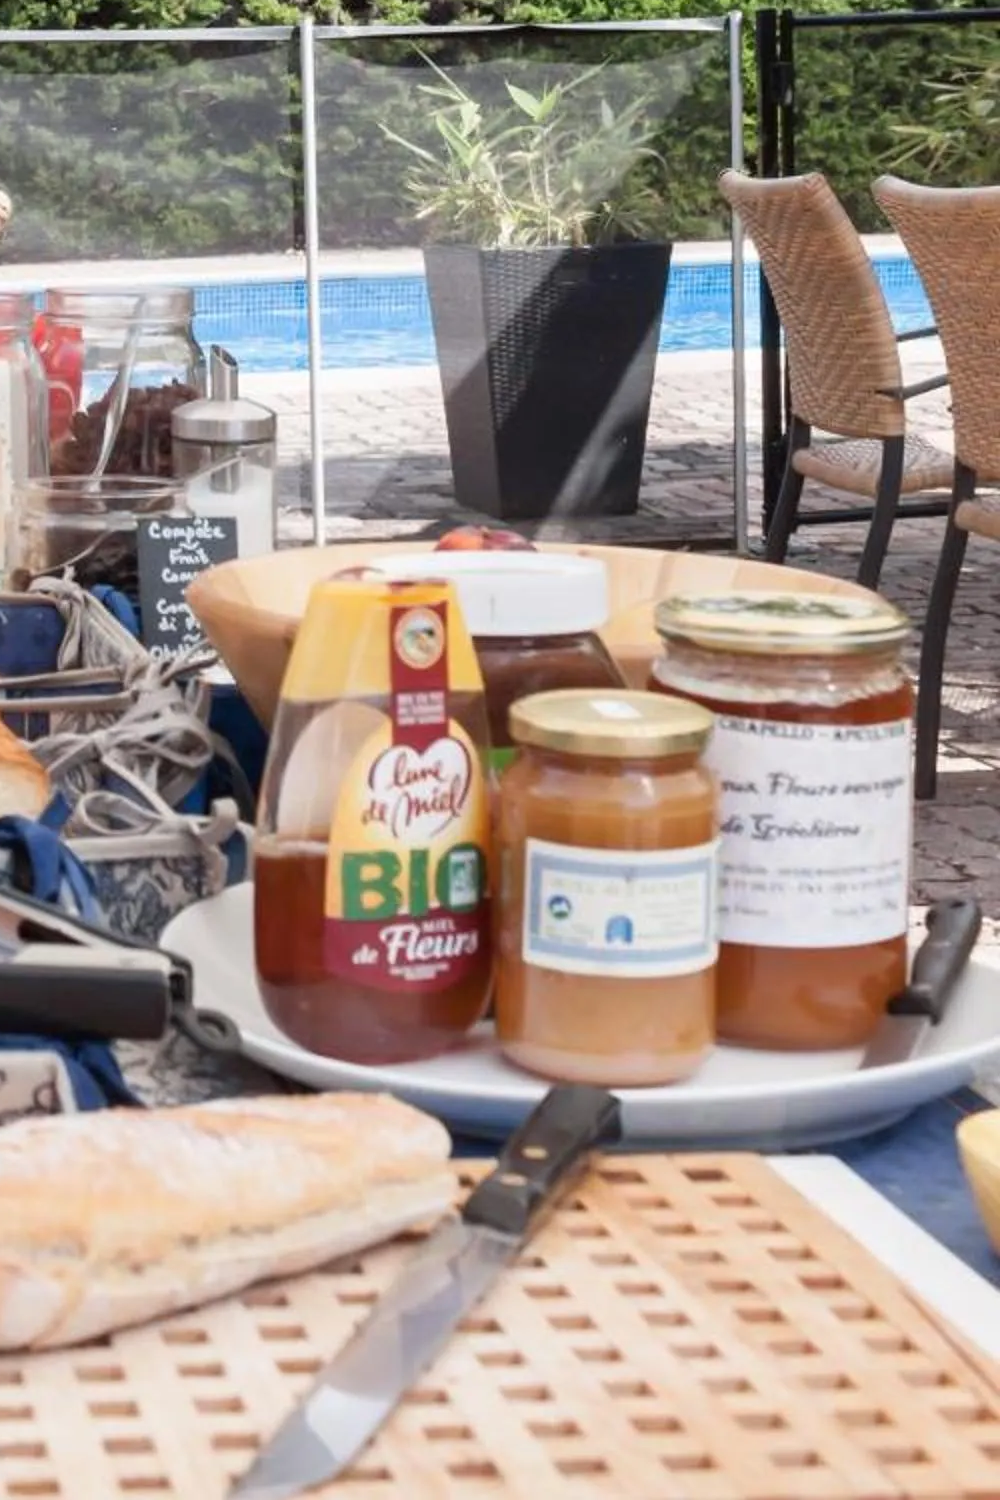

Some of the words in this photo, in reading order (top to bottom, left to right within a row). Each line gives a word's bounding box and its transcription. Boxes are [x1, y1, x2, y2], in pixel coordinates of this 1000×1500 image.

[342, 842, 488, 921] BIO
[352, 944, 379, 965] de
[378, 923, 479, 965] Fleurs
